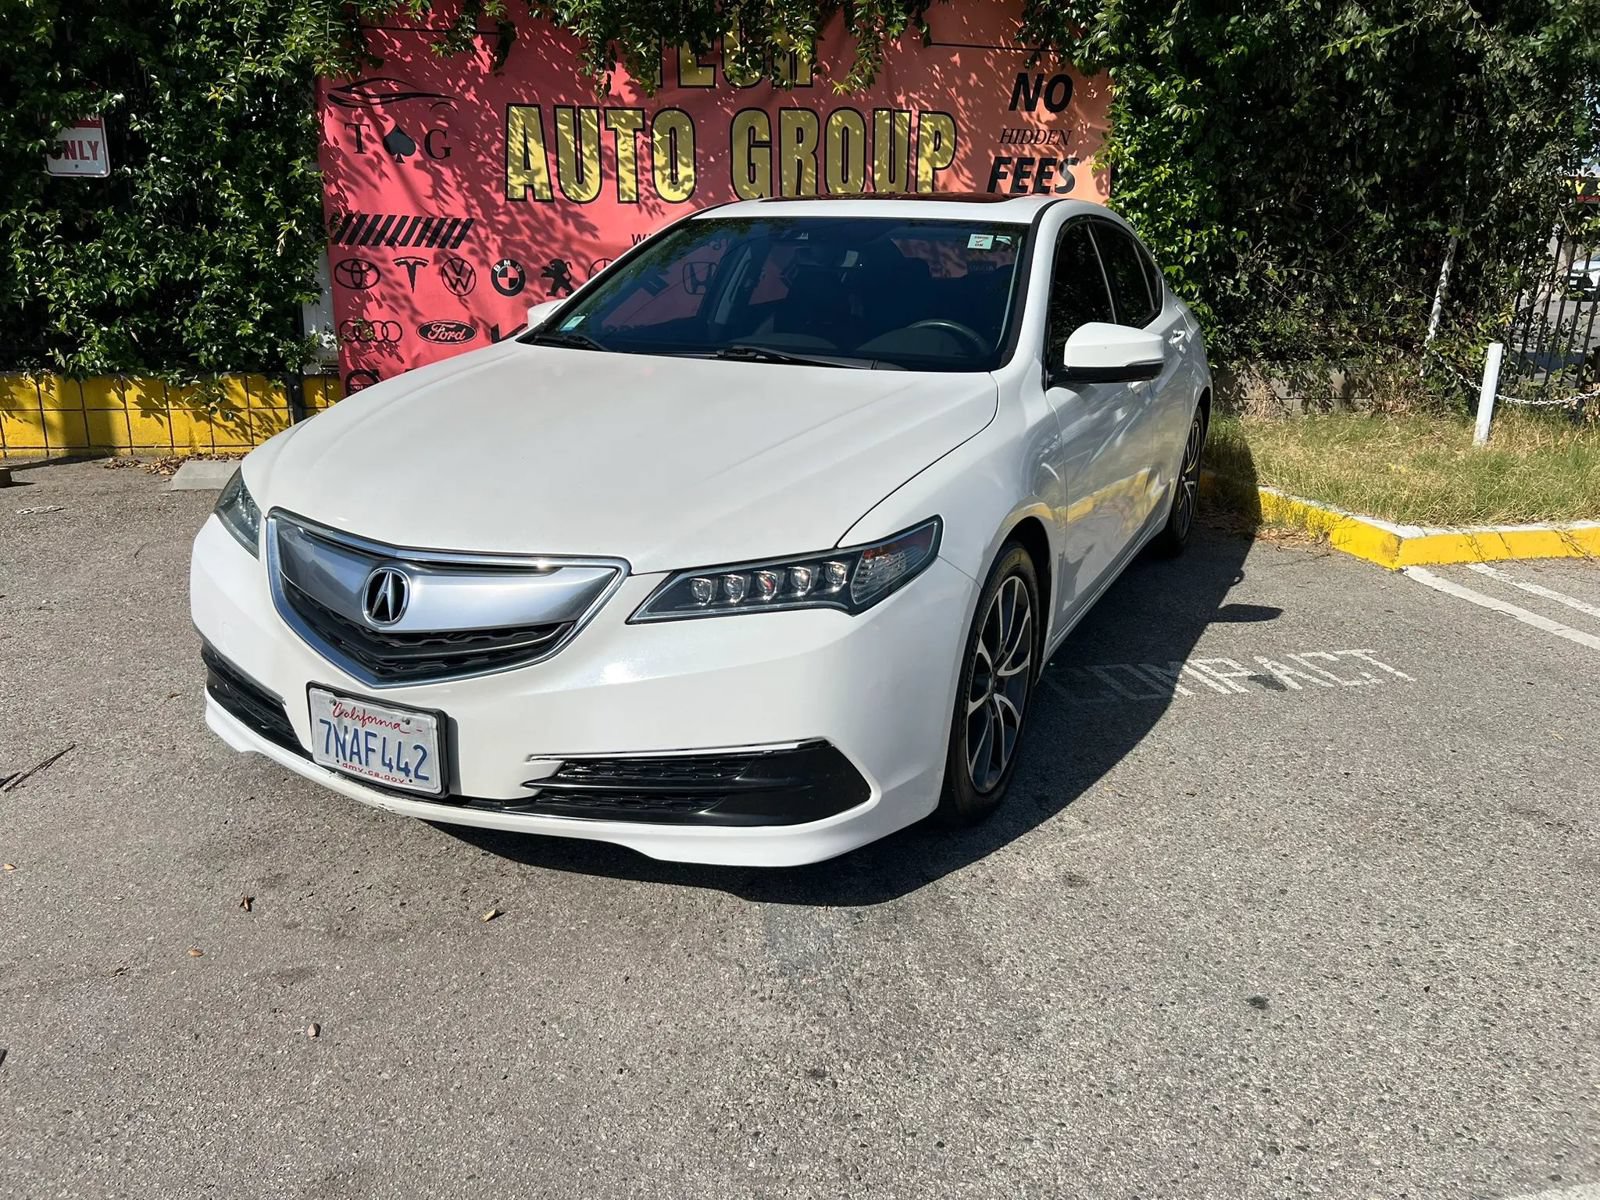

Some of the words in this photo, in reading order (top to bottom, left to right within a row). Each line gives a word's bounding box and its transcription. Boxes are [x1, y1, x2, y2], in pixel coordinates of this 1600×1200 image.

[1008, 73, 1074, 113] NO
[505, 103, 697, 204] AUTO
[730, 107, 957, 200] GROUP
[1000, 128, 1072, 146] HIDDEN
[986, 156, 1080, 194] FEES
[427, 323, 467, 340] Ford
[332, 702, 411, 735] California
[319, 718, 430, 781] 7NAF442
[342, 761, 406, 784] dmv.ca.gov
